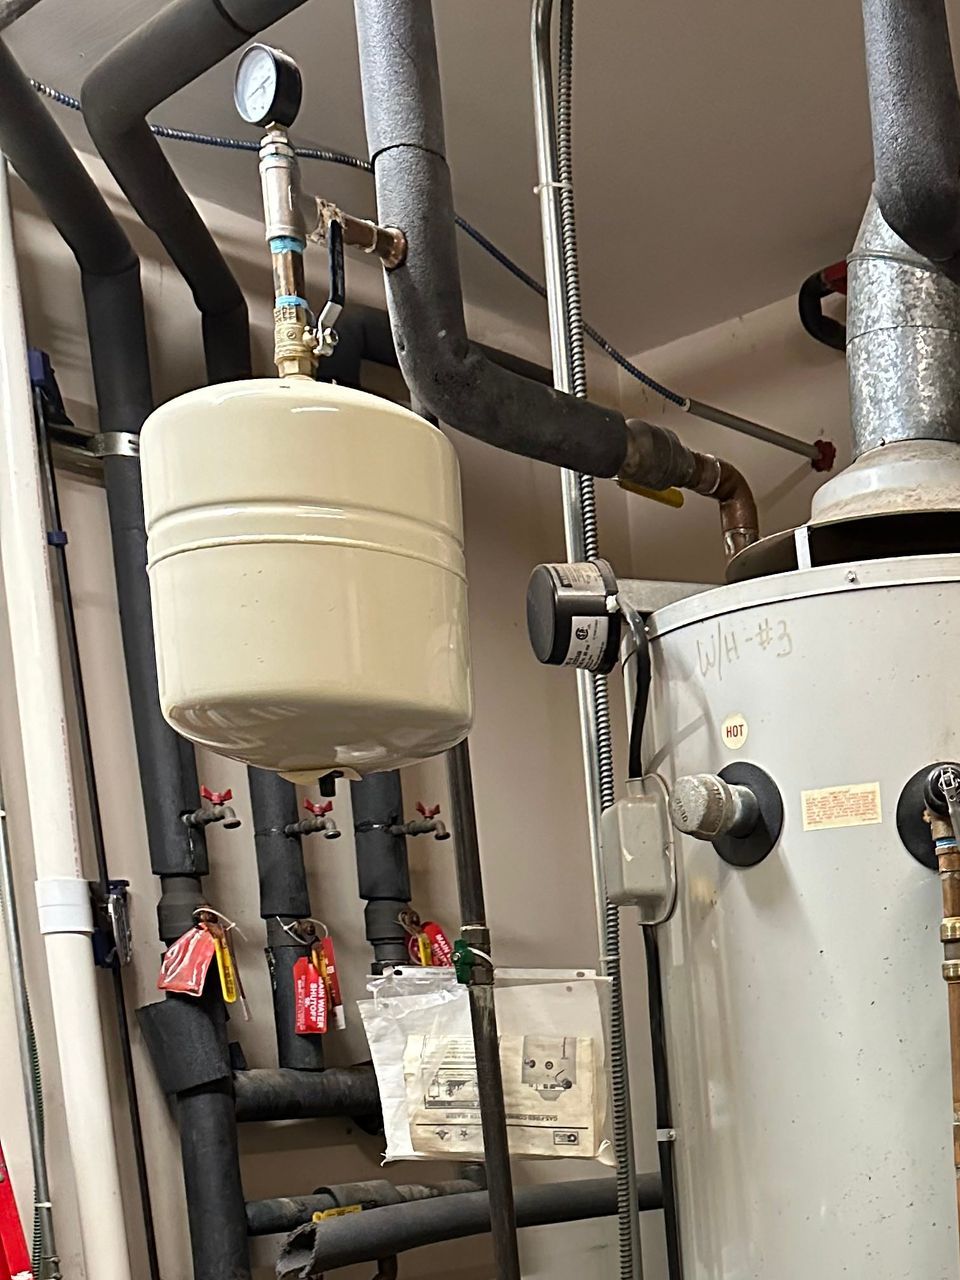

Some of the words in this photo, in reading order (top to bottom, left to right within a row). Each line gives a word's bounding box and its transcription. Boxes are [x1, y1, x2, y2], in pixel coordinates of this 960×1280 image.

[726, 724, 744, 738] HOT
[309, 982, 318, 1022] SHUTOFF
[316, 999, 325, 1028] WATER
